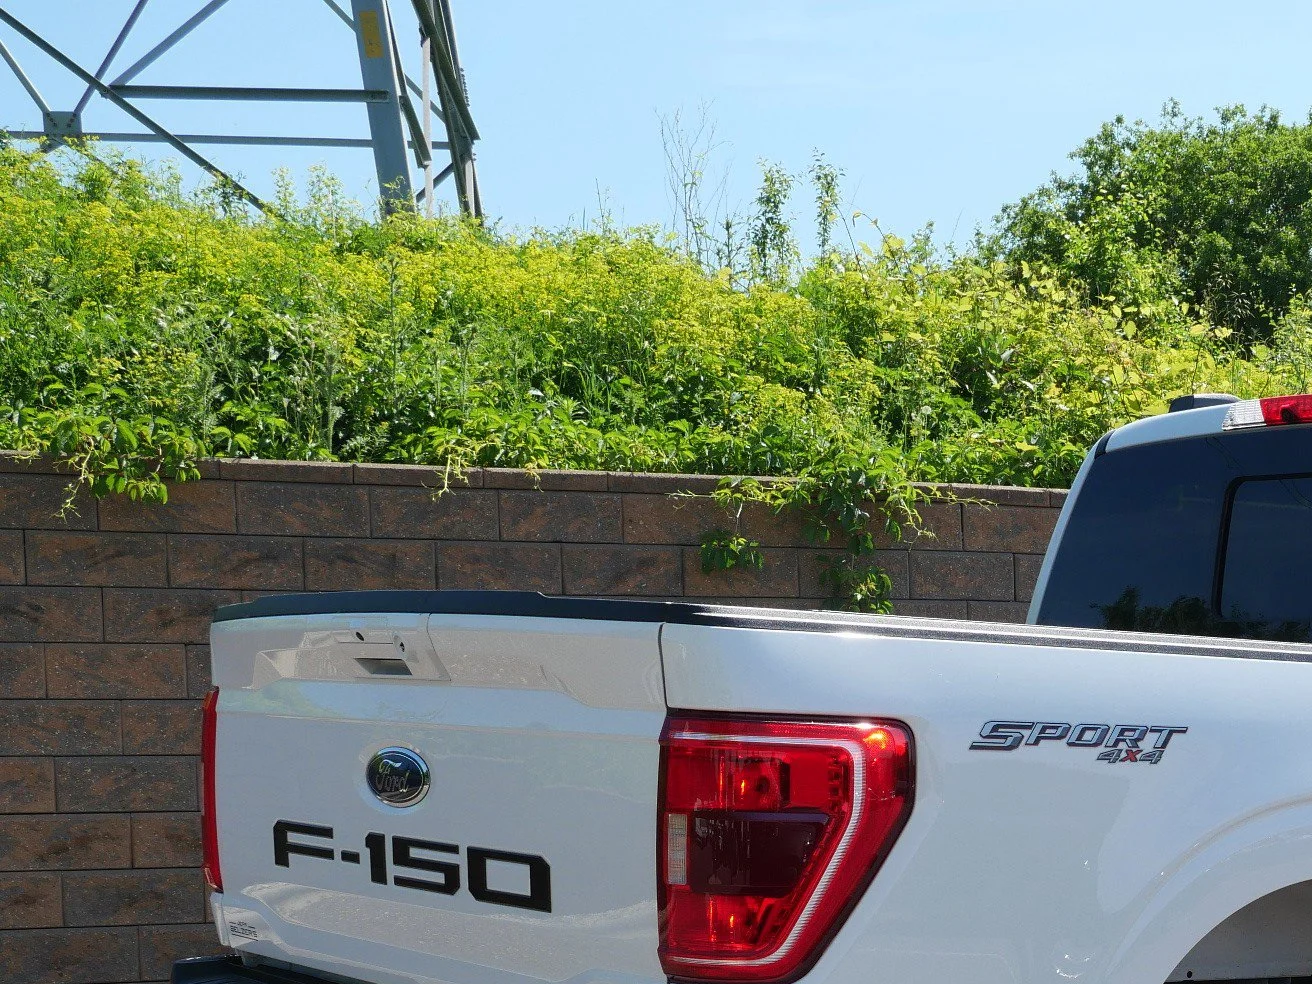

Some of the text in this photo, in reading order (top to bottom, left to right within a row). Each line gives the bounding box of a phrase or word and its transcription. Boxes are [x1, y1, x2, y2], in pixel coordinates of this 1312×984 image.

[970, 721, 1188, 751] SPORT
[1097, 749, 1164, 764] 4x4
[375, 759, 410, 793] Ford
[274, 820, 552, 913] F-150
